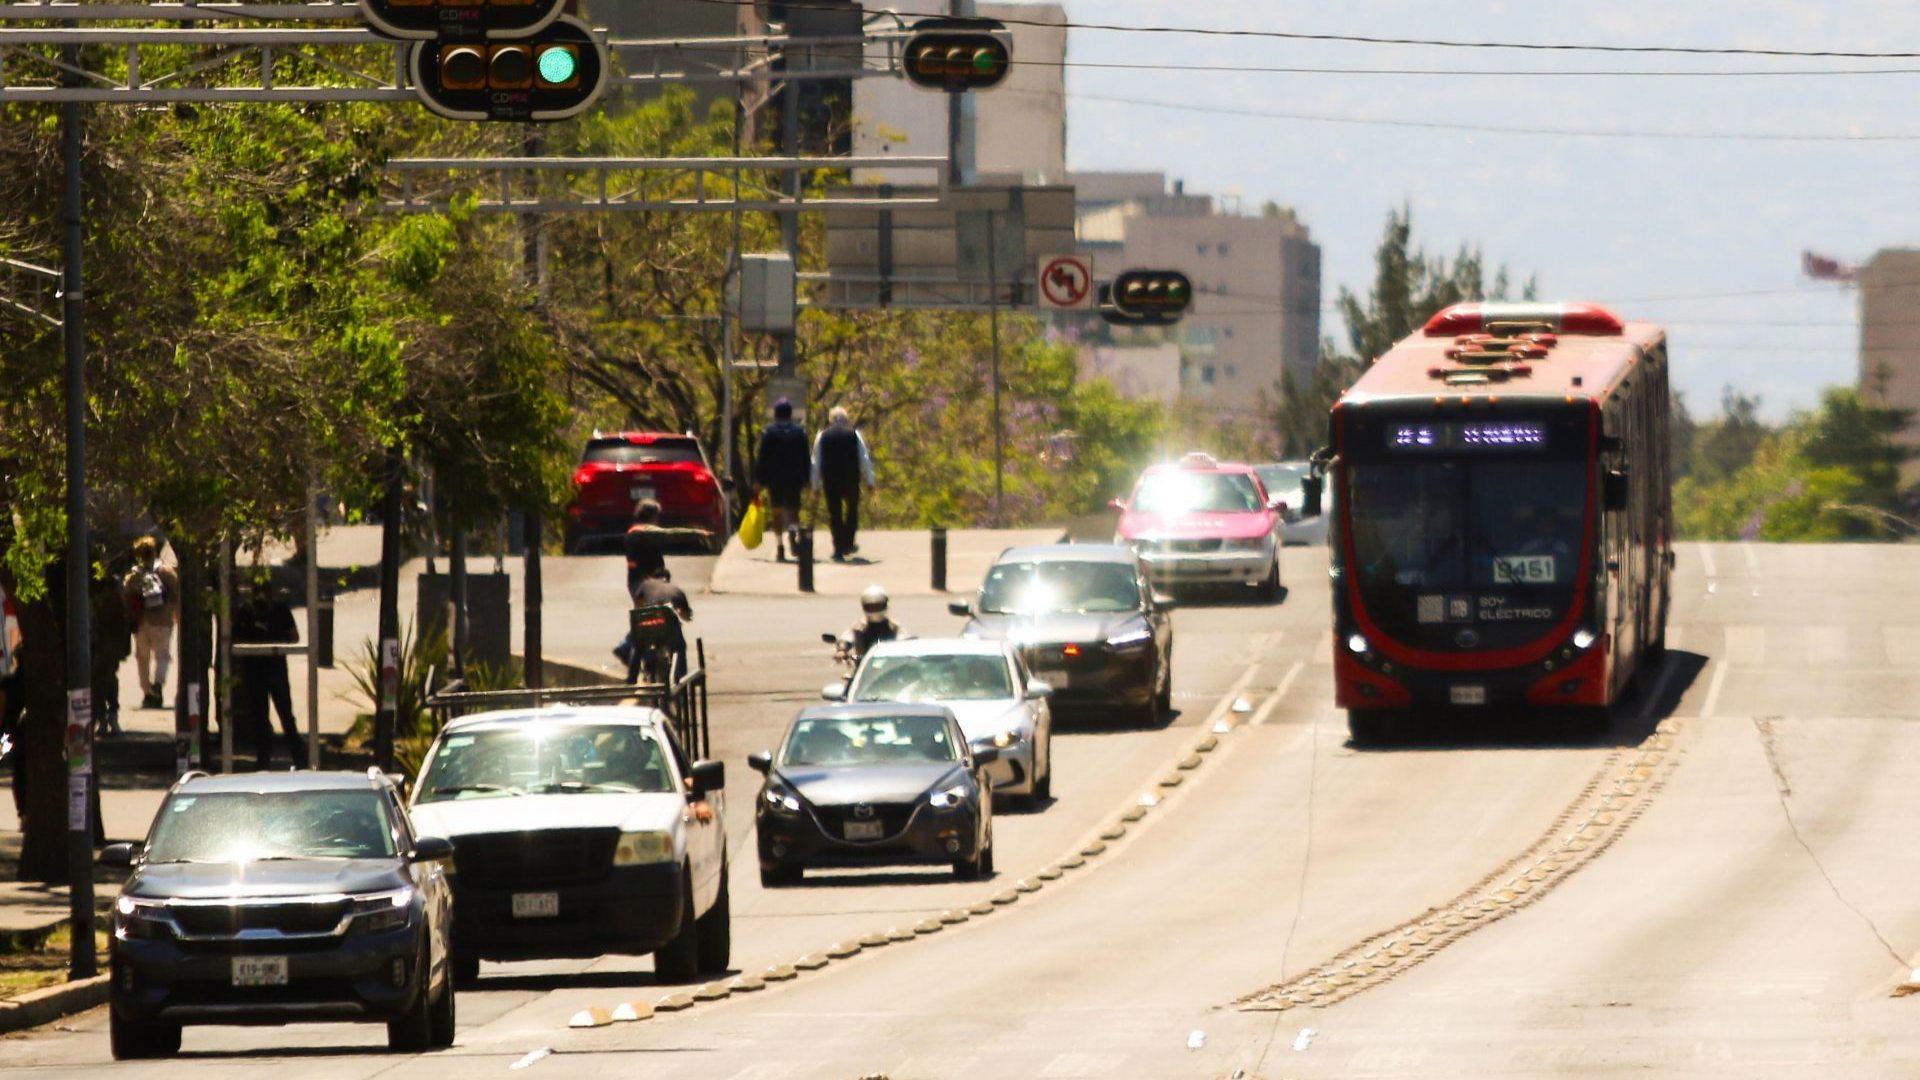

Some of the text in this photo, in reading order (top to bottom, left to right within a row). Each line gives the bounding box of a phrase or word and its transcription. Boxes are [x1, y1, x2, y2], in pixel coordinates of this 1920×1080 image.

[439, 9, 480, 20] CDMX
[491, 92, 528, 103] CDMX
[1479, 597, 1504, 607] SOY
